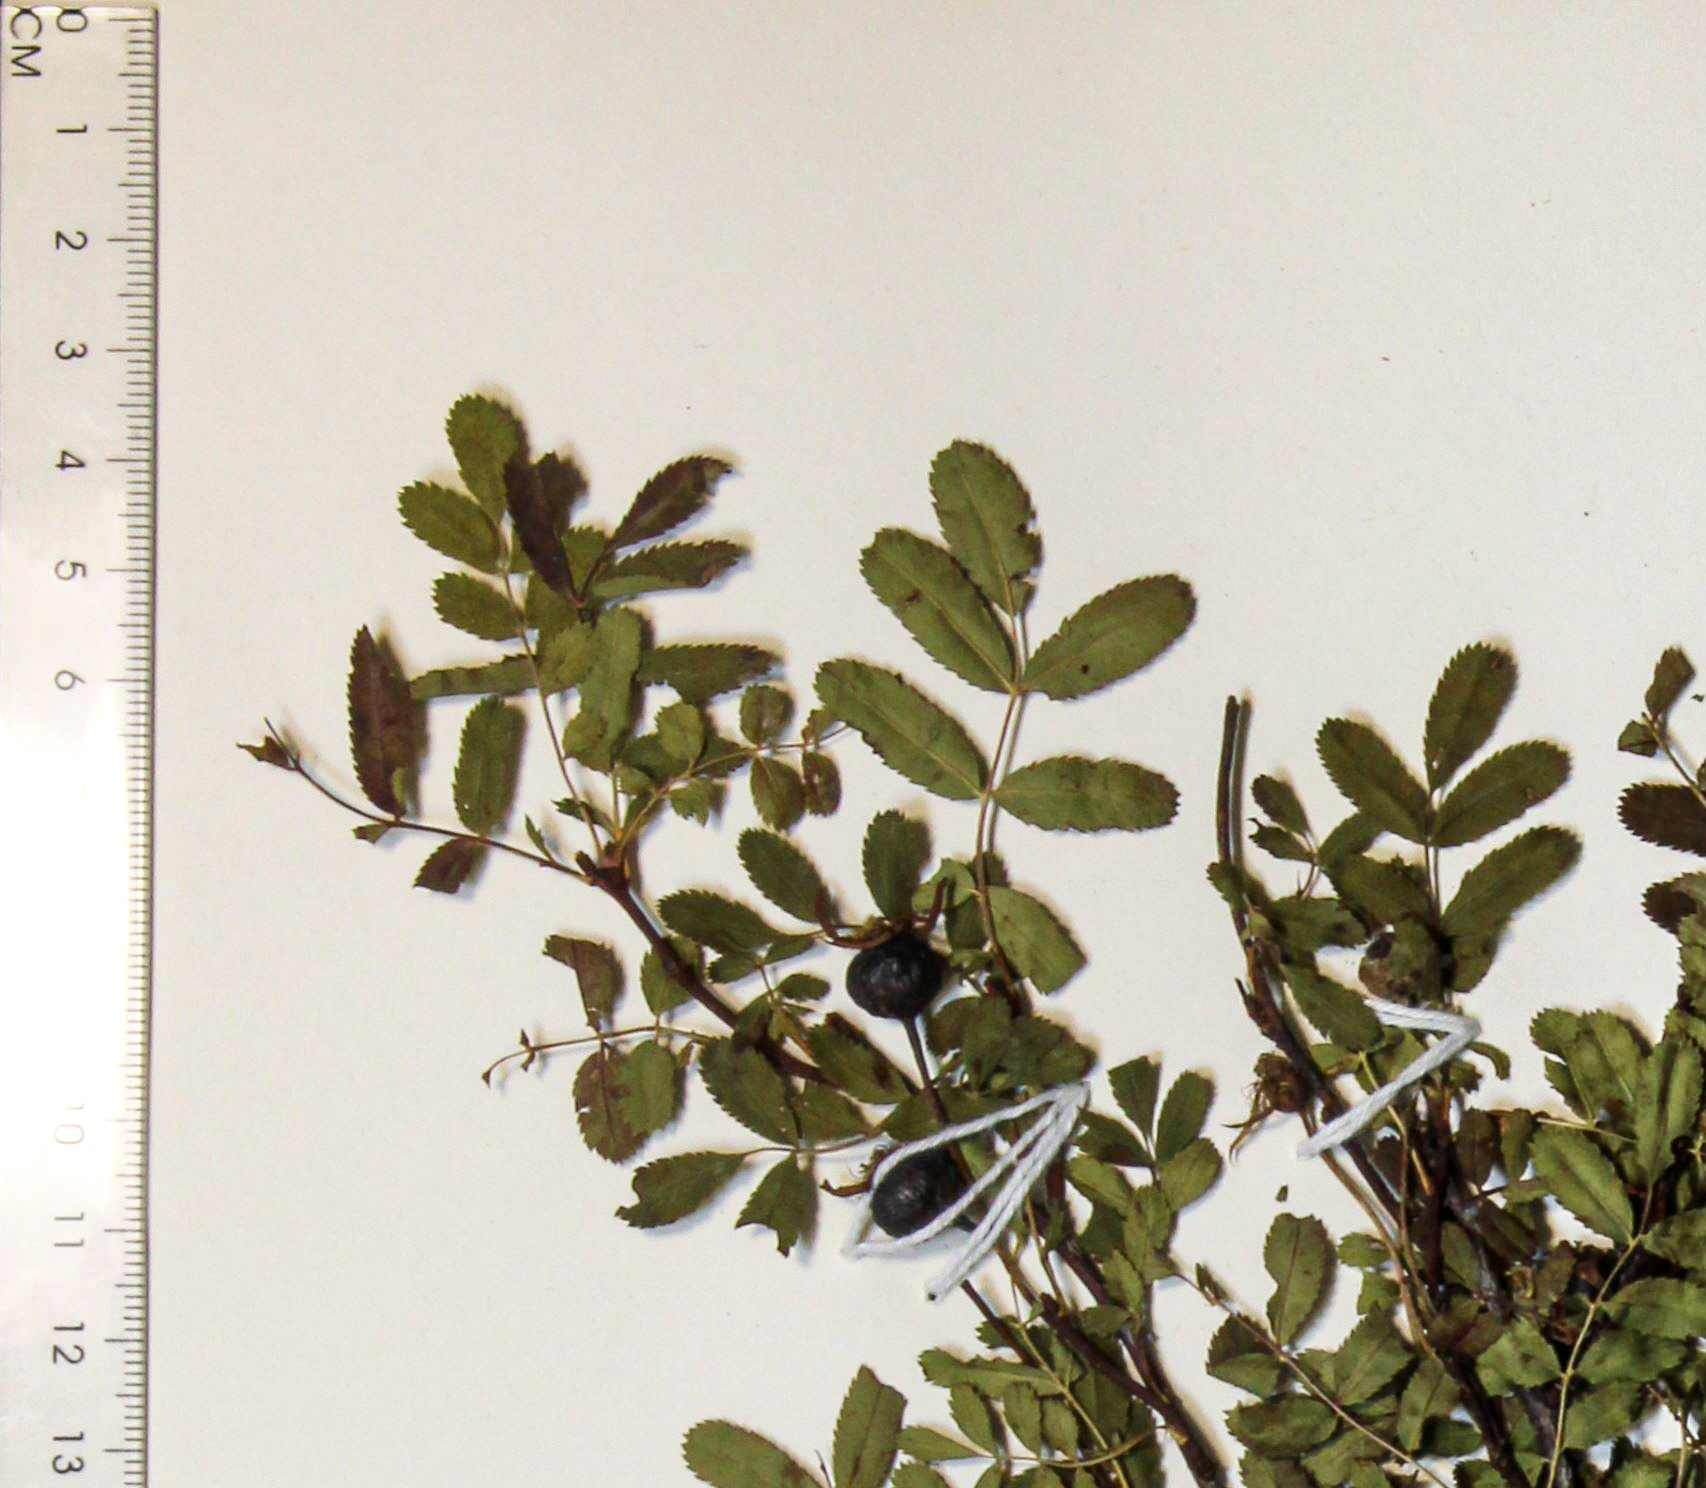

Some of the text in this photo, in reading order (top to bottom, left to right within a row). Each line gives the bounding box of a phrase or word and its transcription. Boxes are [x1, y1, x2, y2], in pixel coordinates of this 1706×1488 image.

[56, 7, 89, 33] 0
[9, 8, 42, 77] CM
[55, 124, 88, 134] 1
[55, 230, 89, 251] 2
[54, 340, 88, 361] 3
[55, 449, 87, 471] 4
[54, 559, 87, 581] 5
[53, 669, 86, 692] 6
[53, 1212, 85, 1248] 11
[52, 1322, 85, 1365] 12
[51, 1431, 85, 1475] 13
